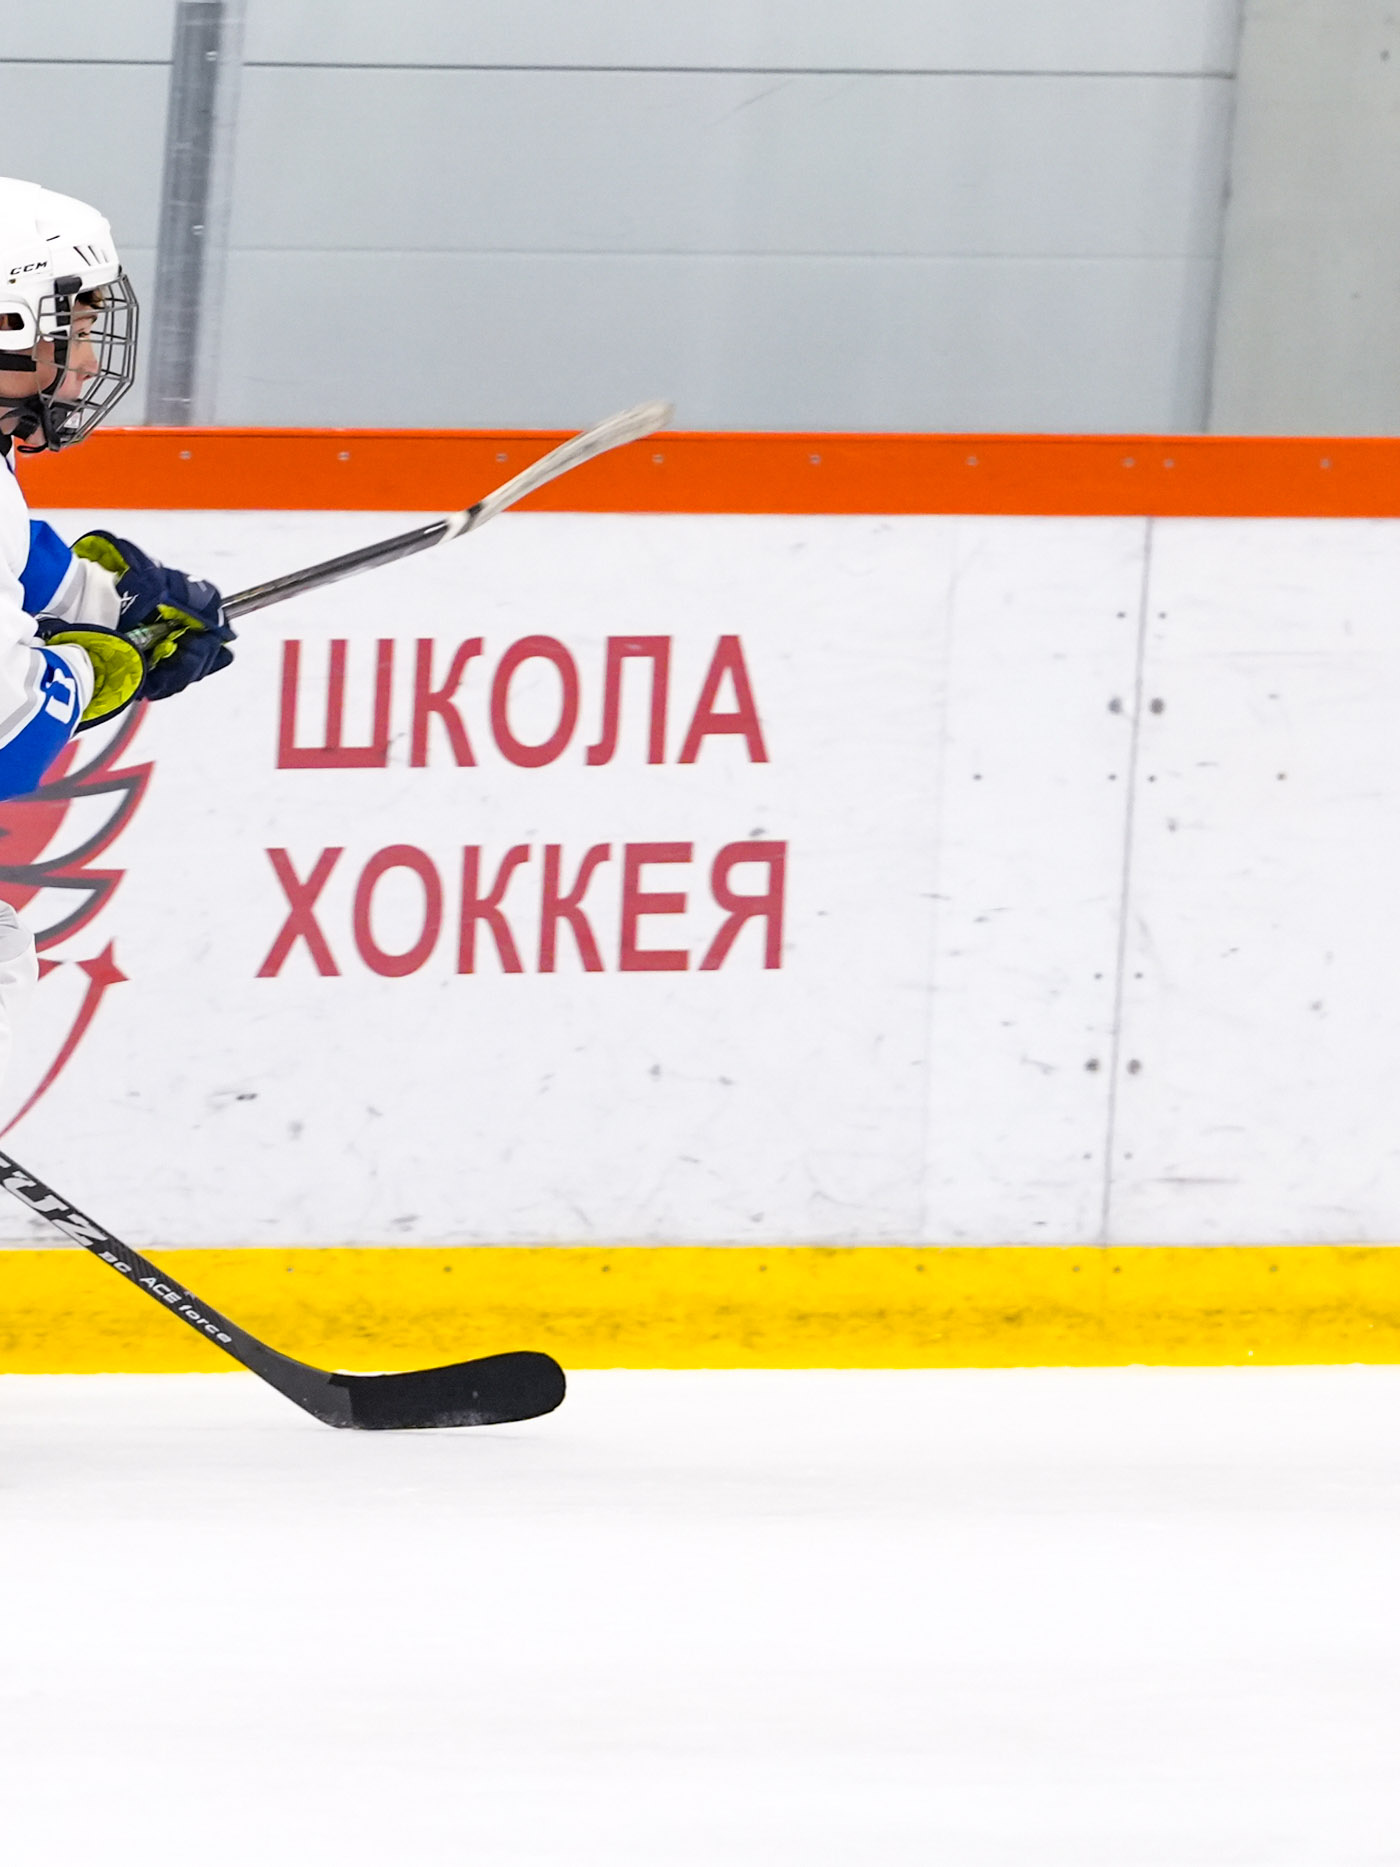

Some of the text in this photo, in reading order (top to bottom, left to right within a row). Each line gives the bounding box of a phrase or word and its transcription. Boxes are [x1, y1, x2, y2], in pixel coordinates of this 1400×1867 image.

[10, 260, 49, 276] CCM
[275, 634, 770, 769] ШКОЛА
[254, 839, 789, 978] ХОККЕЯ
[140, 1276, 181, 1304] ACE
[179, 1304, 232, 1344] force
